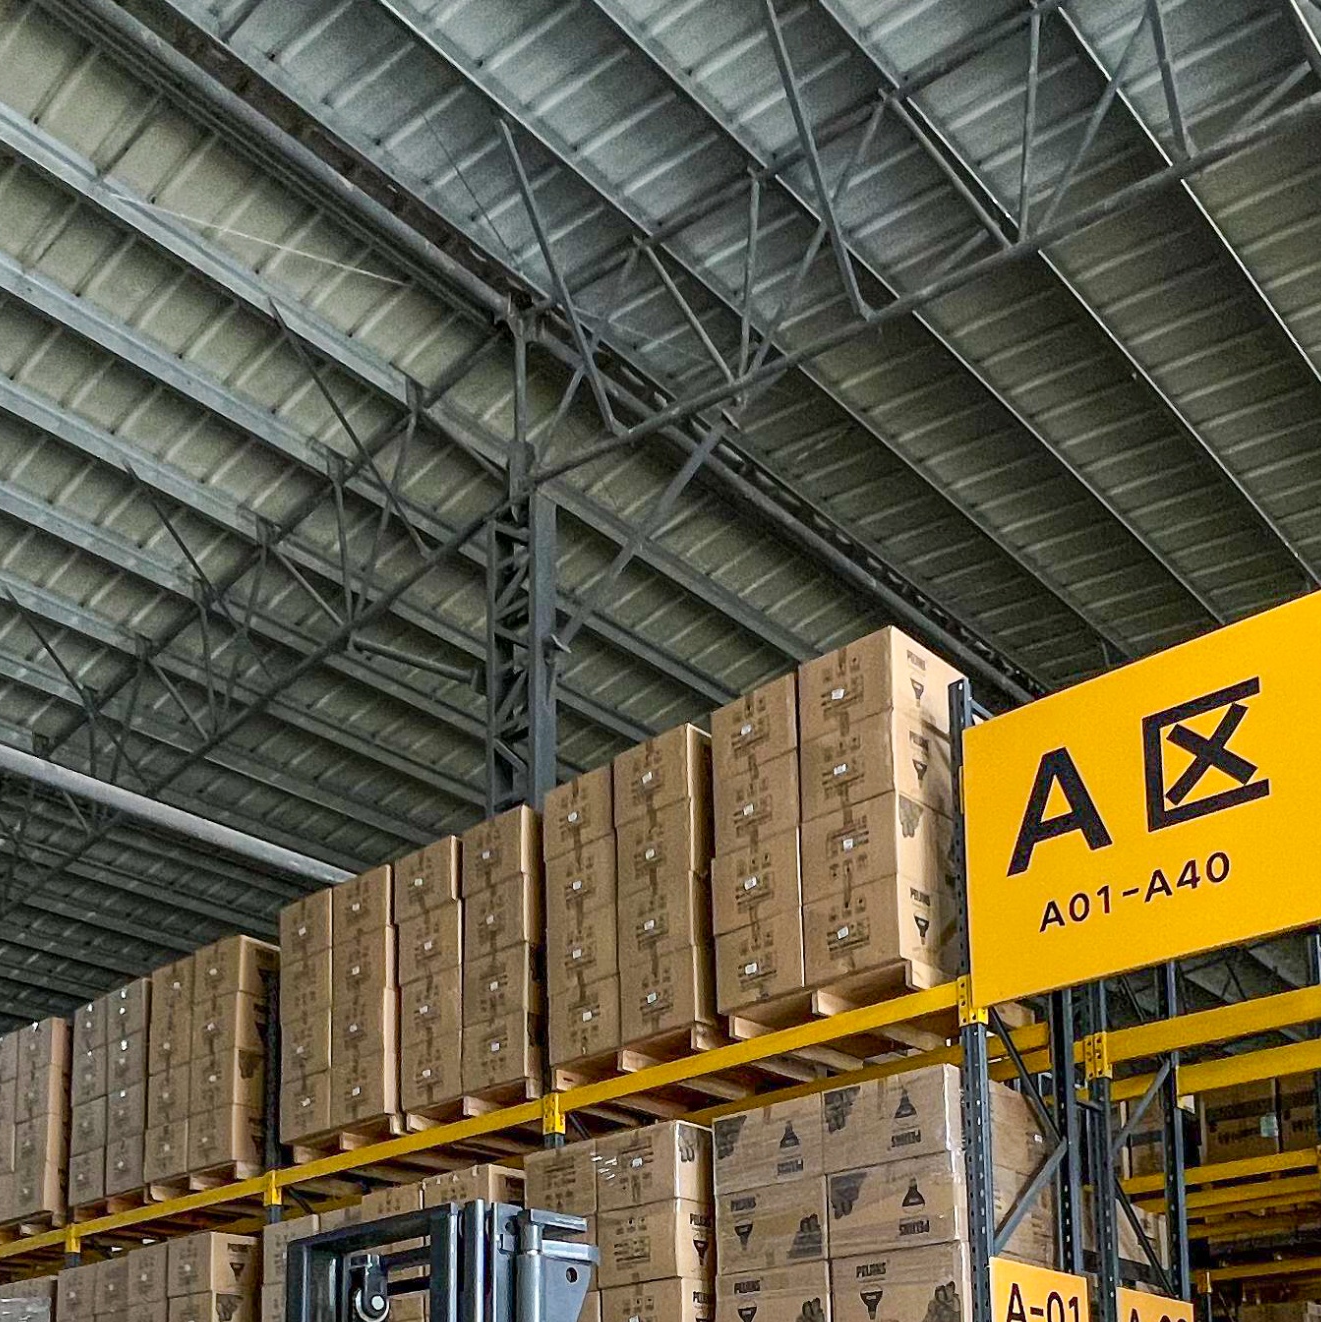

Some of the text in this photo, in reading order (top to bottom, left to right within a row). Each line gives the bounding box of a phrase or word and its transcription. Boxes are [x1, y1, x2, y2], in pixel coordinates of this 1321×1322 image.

[1007, 676, 1270, 877] A 区
[1039, 852, 1232, 932] A01-A40
